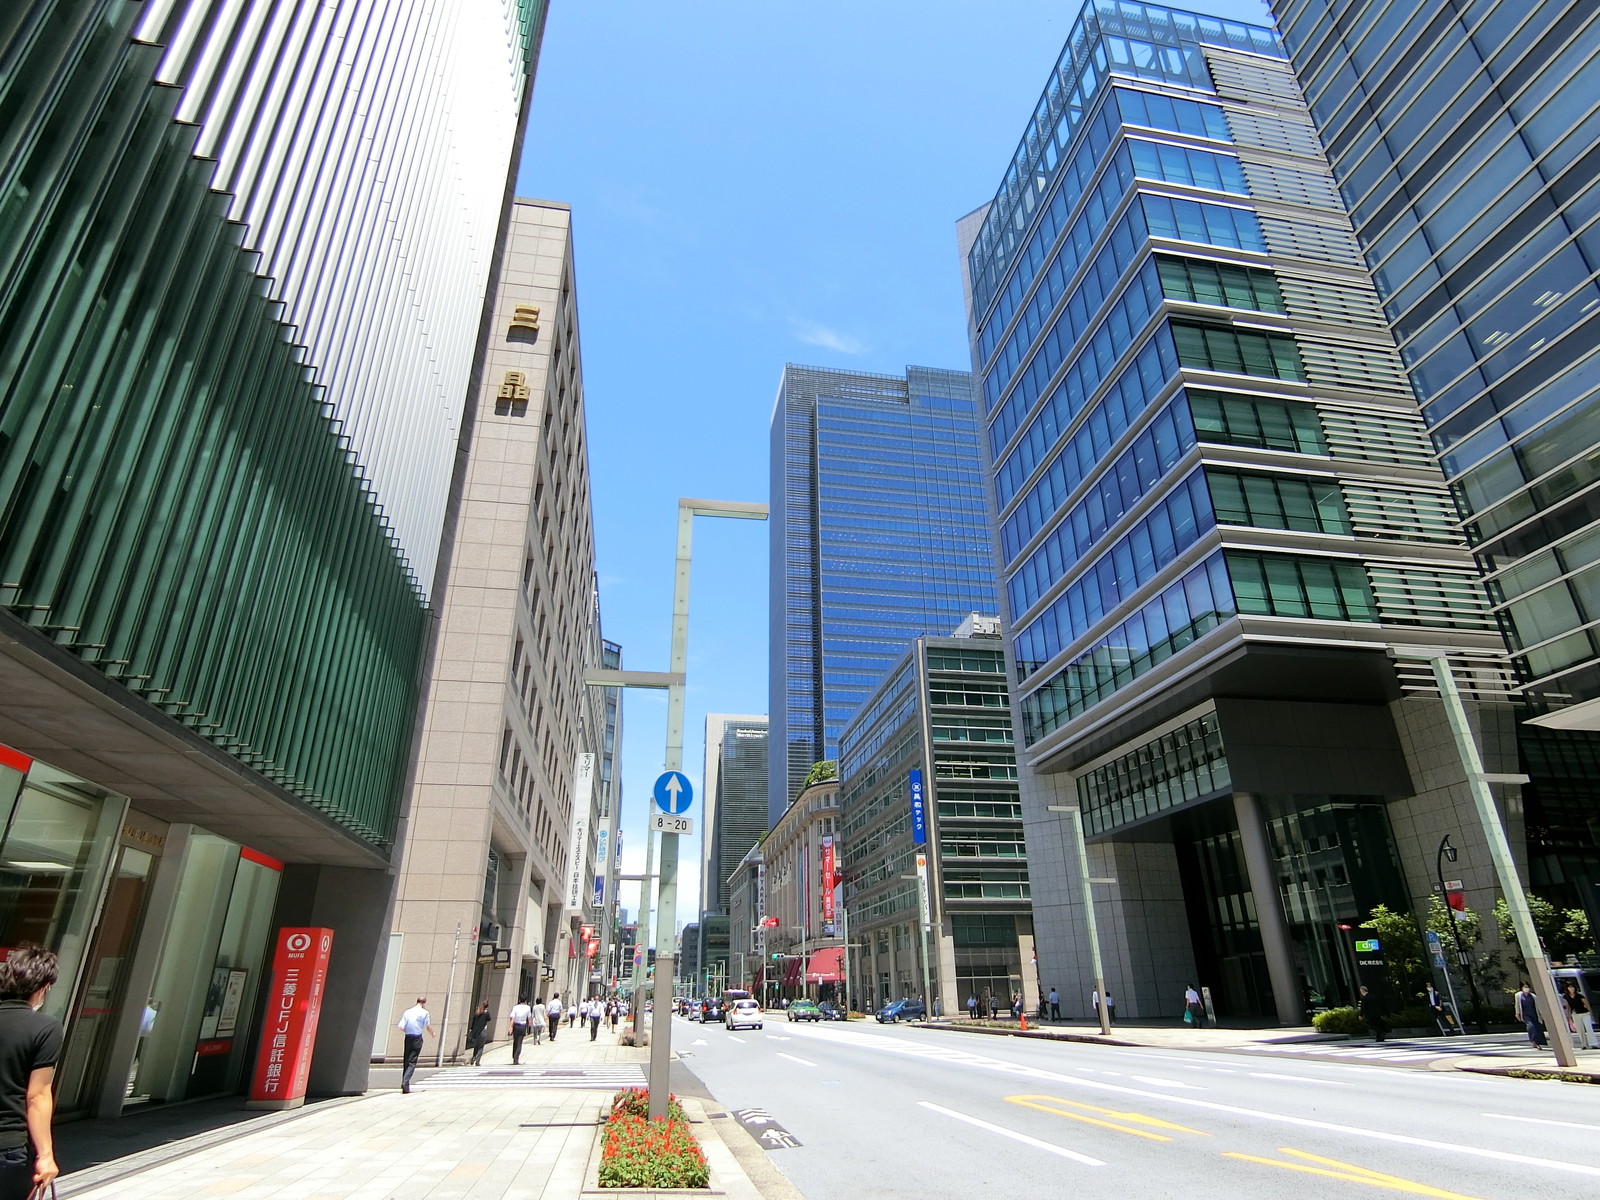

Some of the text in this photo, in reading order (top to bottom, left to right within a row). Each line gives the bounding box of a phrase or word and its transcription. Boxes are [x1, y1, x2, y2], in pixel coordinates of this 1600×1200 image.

[498, 304, 540, 401] 三晶
[584, 754, 592, 778] モリマー
[264, 968, 300, 1093] 三菱UFJ信託銀行
